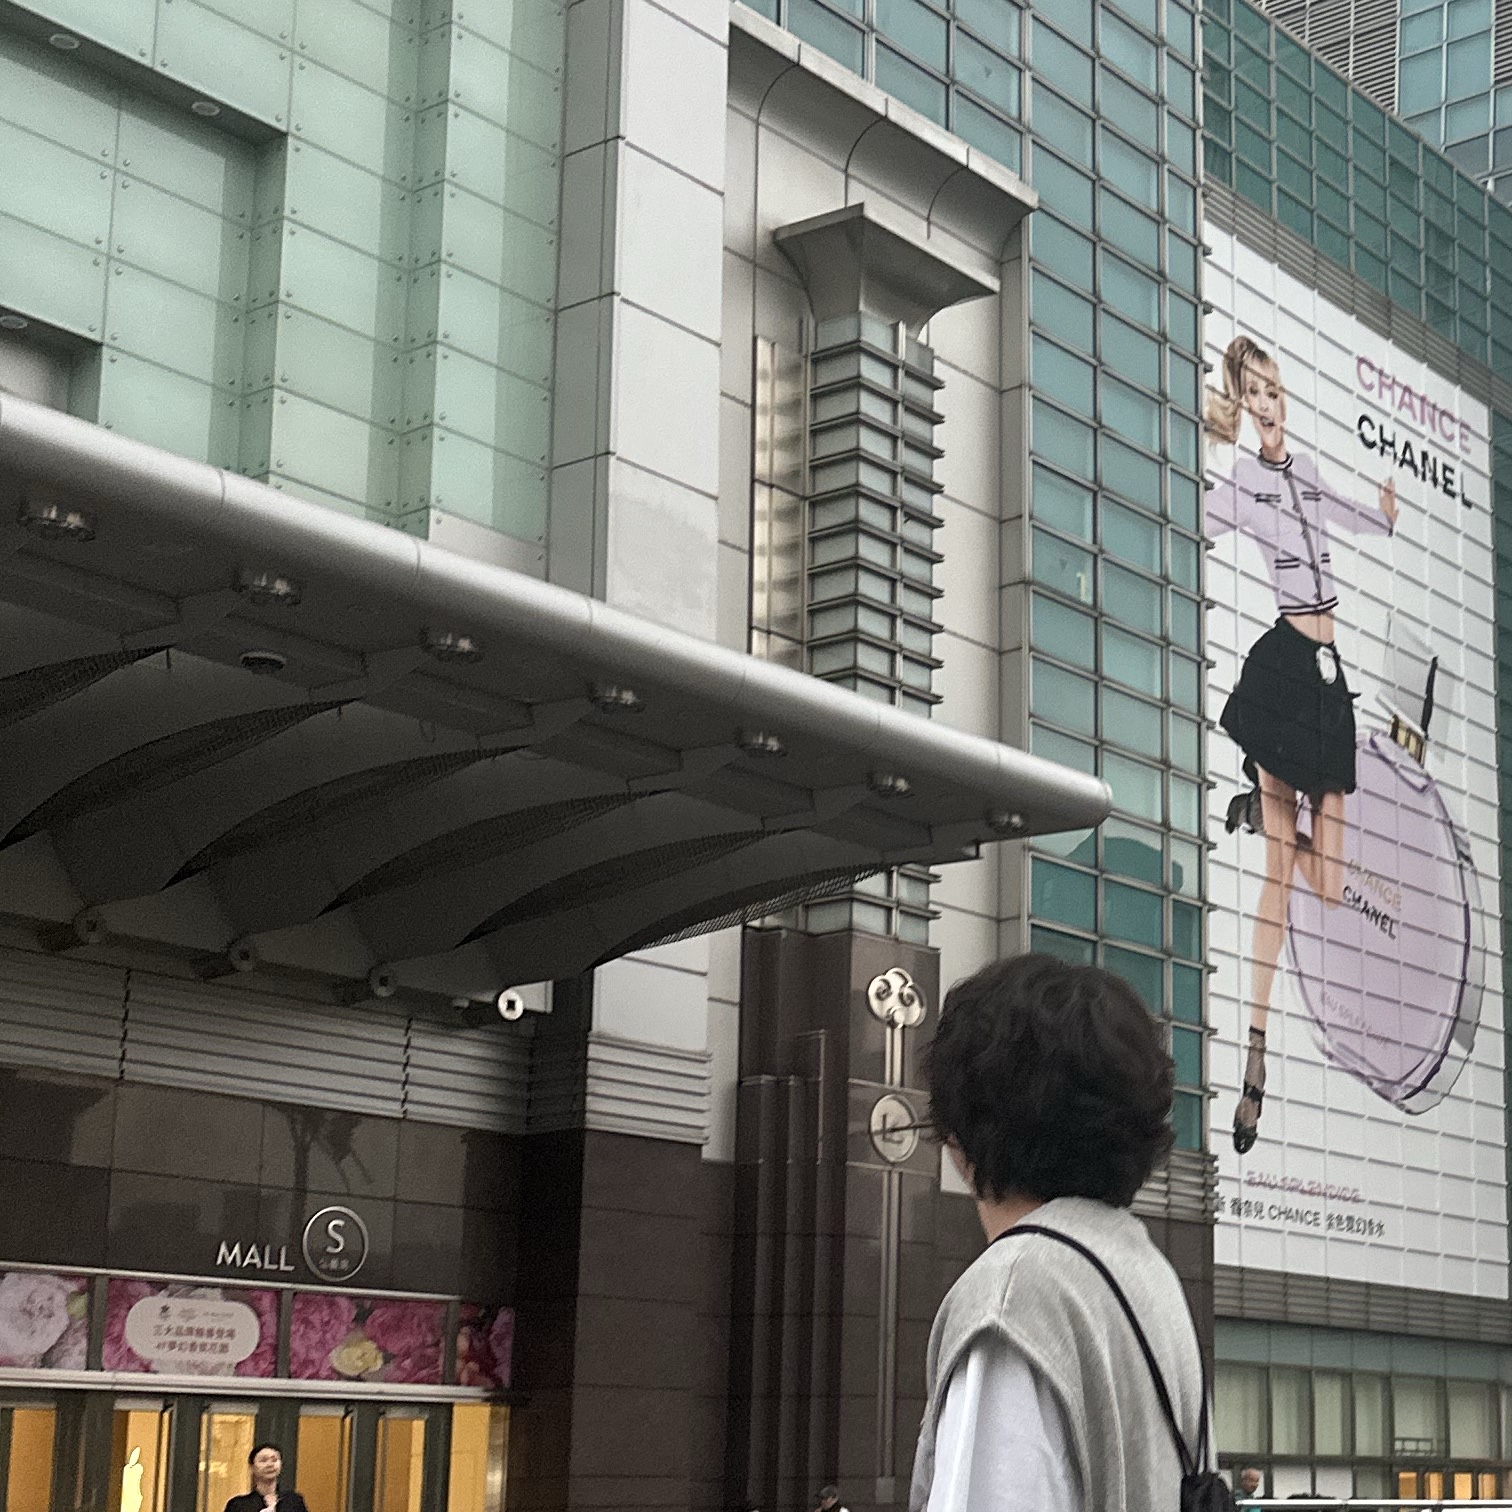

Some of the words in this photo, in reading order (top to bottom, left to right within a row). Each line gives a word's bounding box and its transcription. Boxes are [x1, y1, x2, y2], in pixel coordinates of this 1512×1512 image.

[1356, 357, 1472, 454] CHANCE
[1357, 414, 1474, 510] CHANEL
[1343, 885, 1396, 940] CHANEL
[1268, 1204, 1321, 1227] CHANCE
[216, 1240, 295, 1272] MALL
[326, 1219, 345, 1253] S
